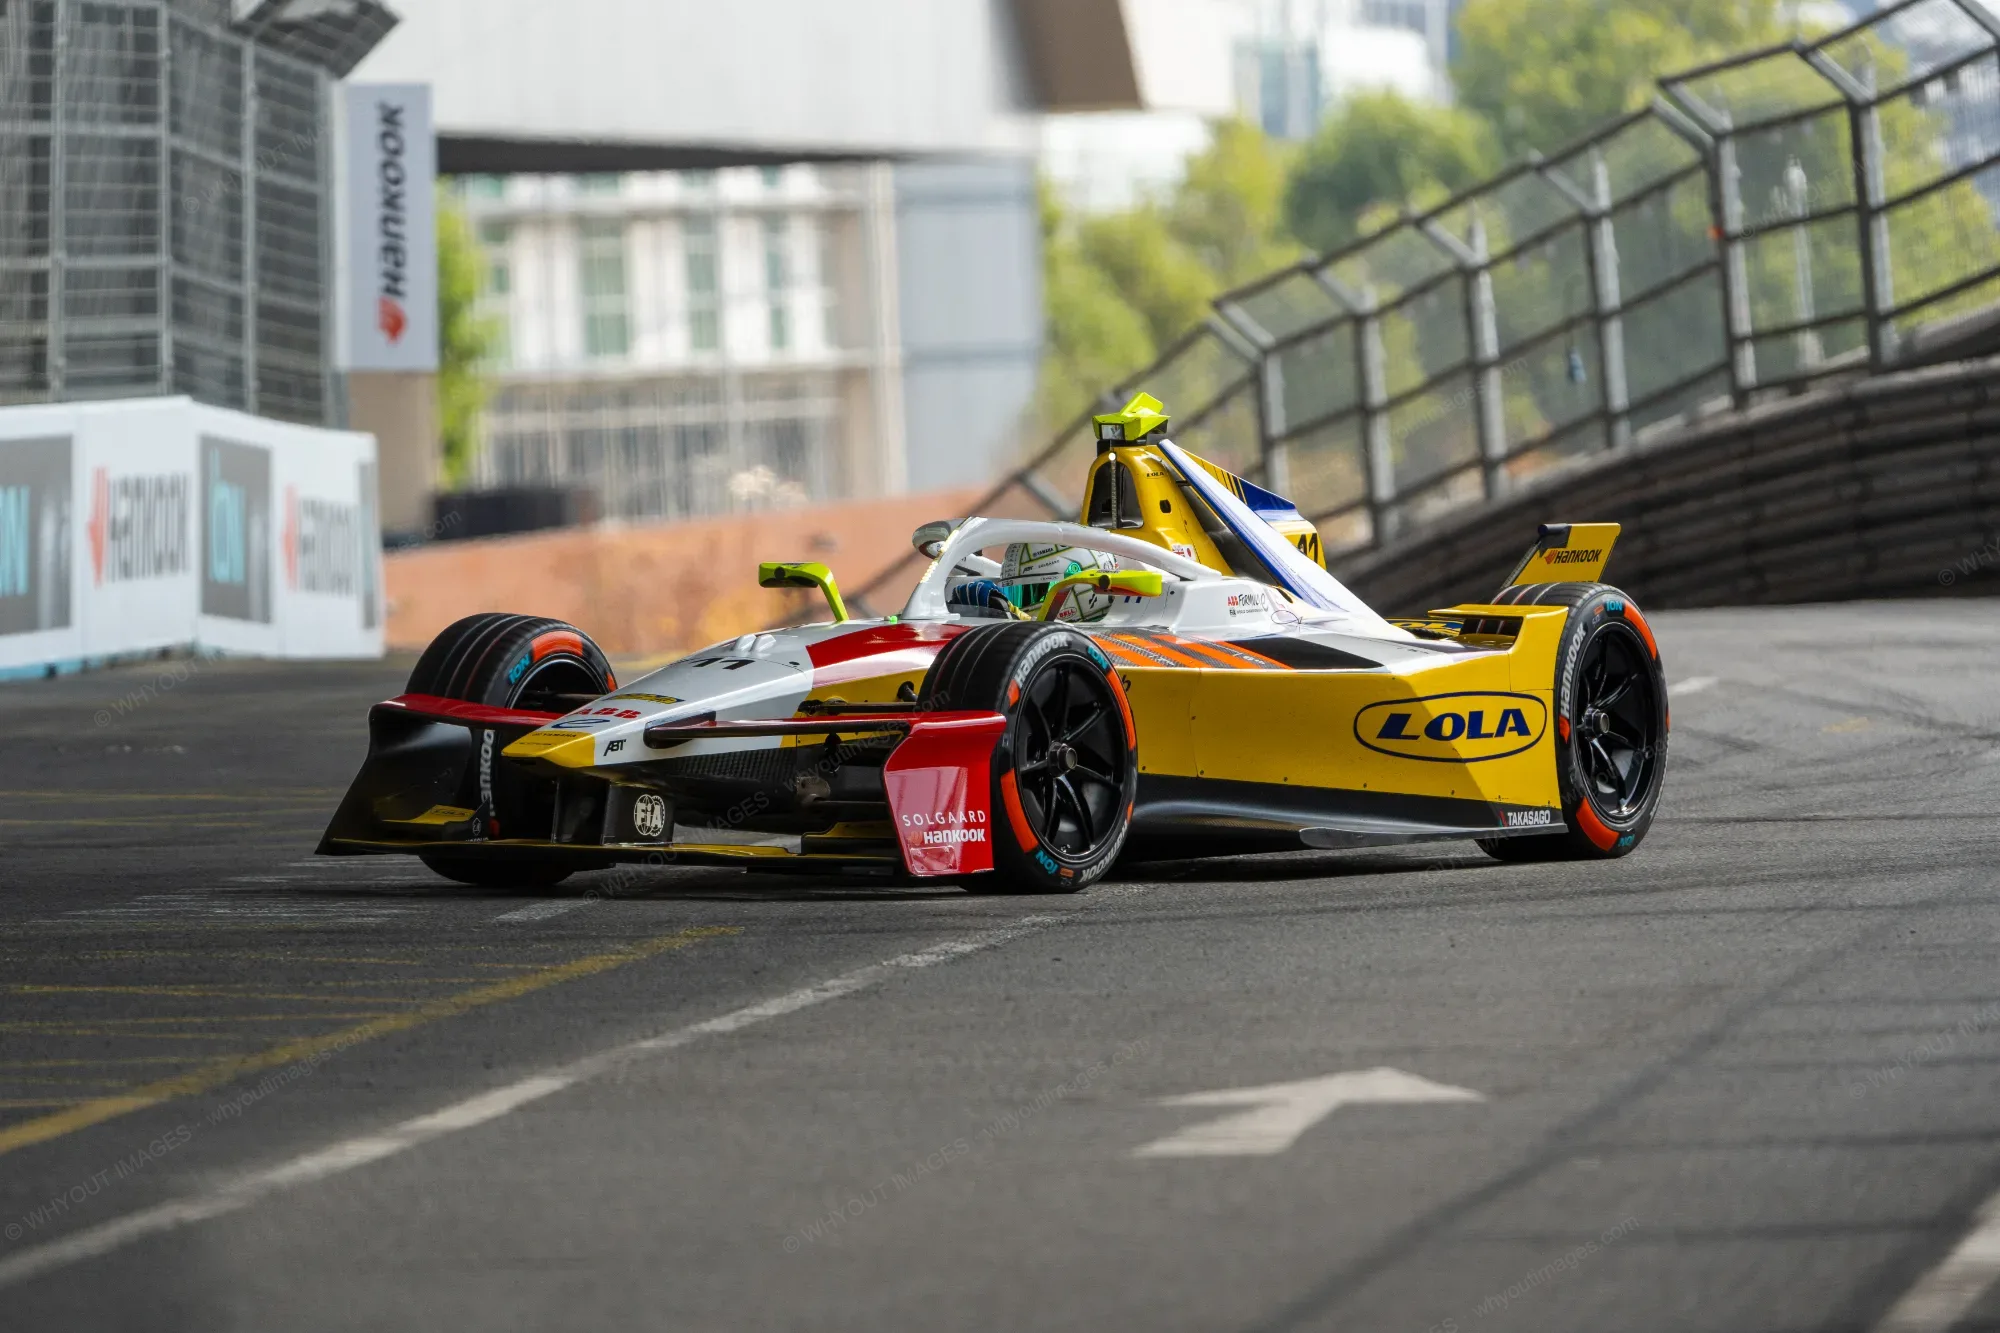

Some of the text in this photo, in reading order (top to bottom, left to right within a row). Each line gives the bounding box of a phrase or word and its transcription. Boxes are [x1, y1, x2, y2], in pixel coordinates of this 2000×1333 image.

[1059, 609, 1075, 619] BELL
[1376, 708, 1532, 741] LOLA
[603, 739, 627, 757] ABT
[902, 809, 986, 827] SOLGAARD
[1506, 809, 1551, 826] TAKASAGO
